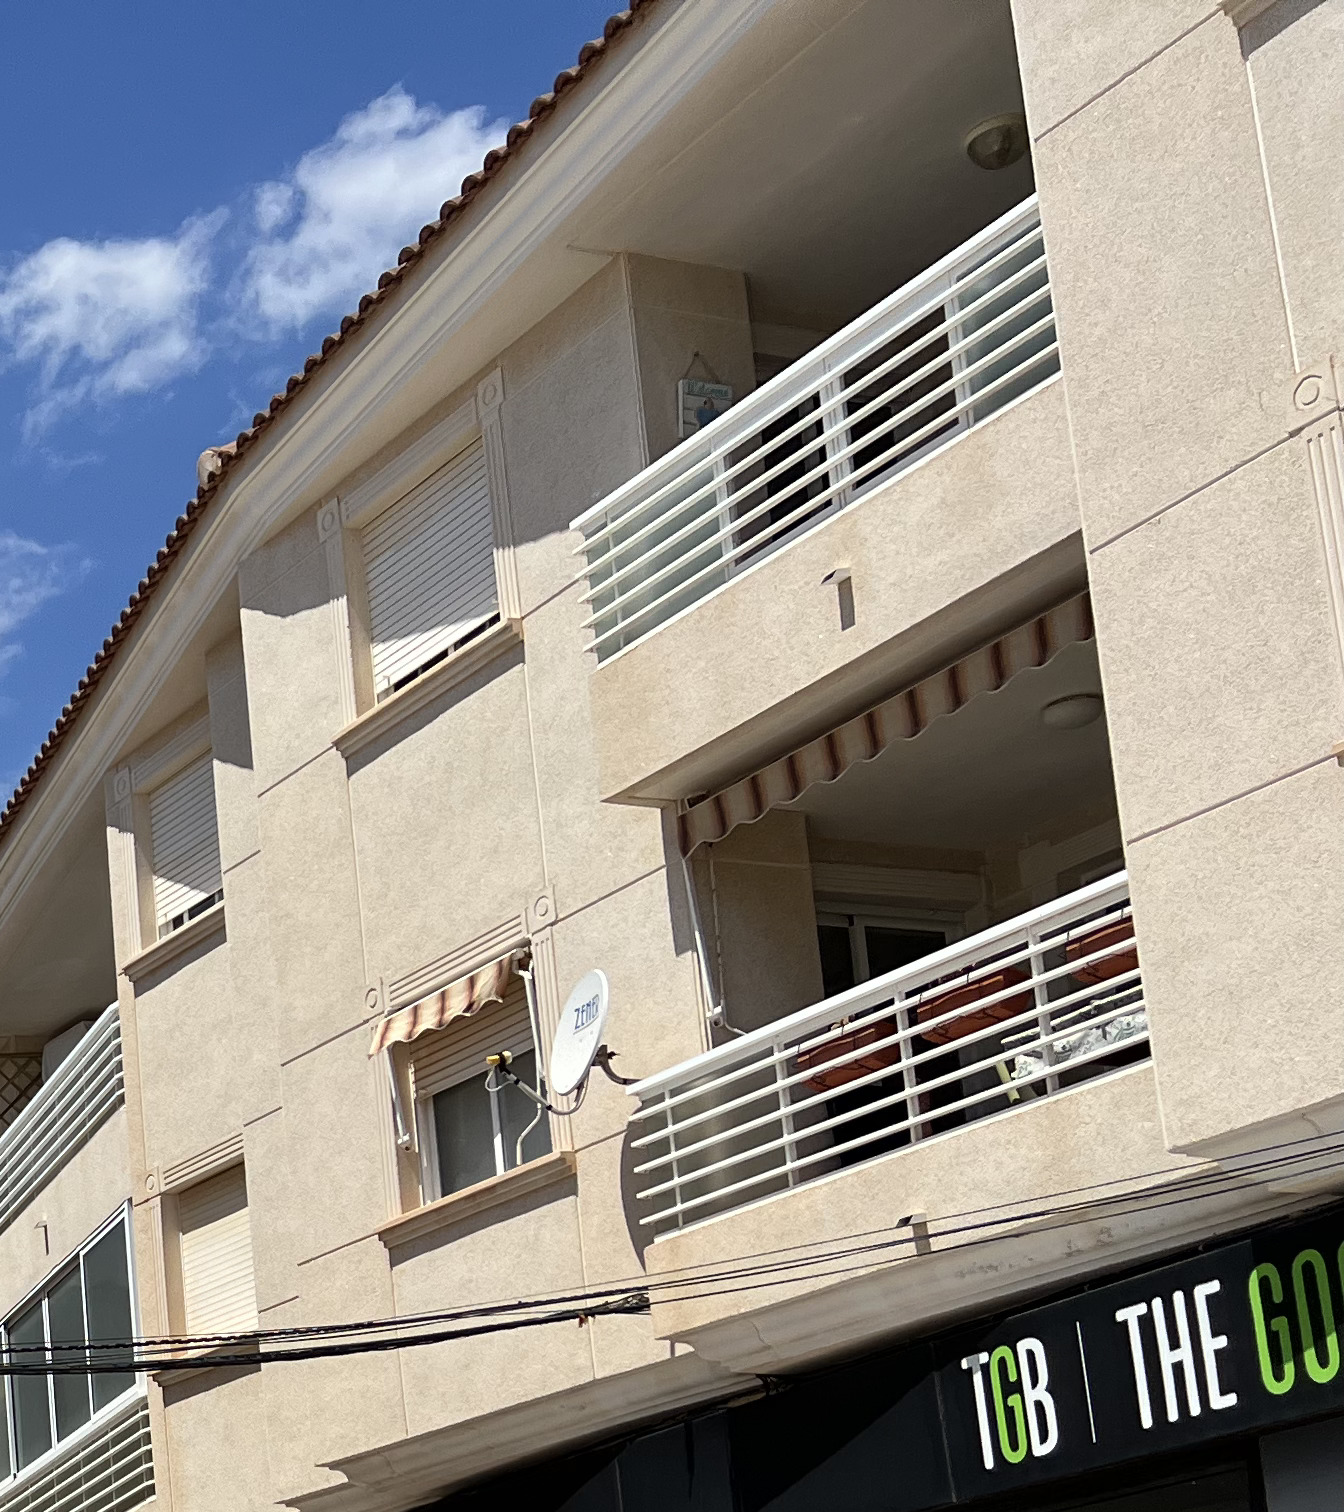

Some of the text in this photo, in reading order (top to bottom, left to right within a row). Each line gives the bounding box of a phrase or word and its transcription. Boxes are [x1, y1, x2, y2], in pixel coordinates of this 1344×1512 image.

[961, 1239, 1344, 1470] TGB THE GO
